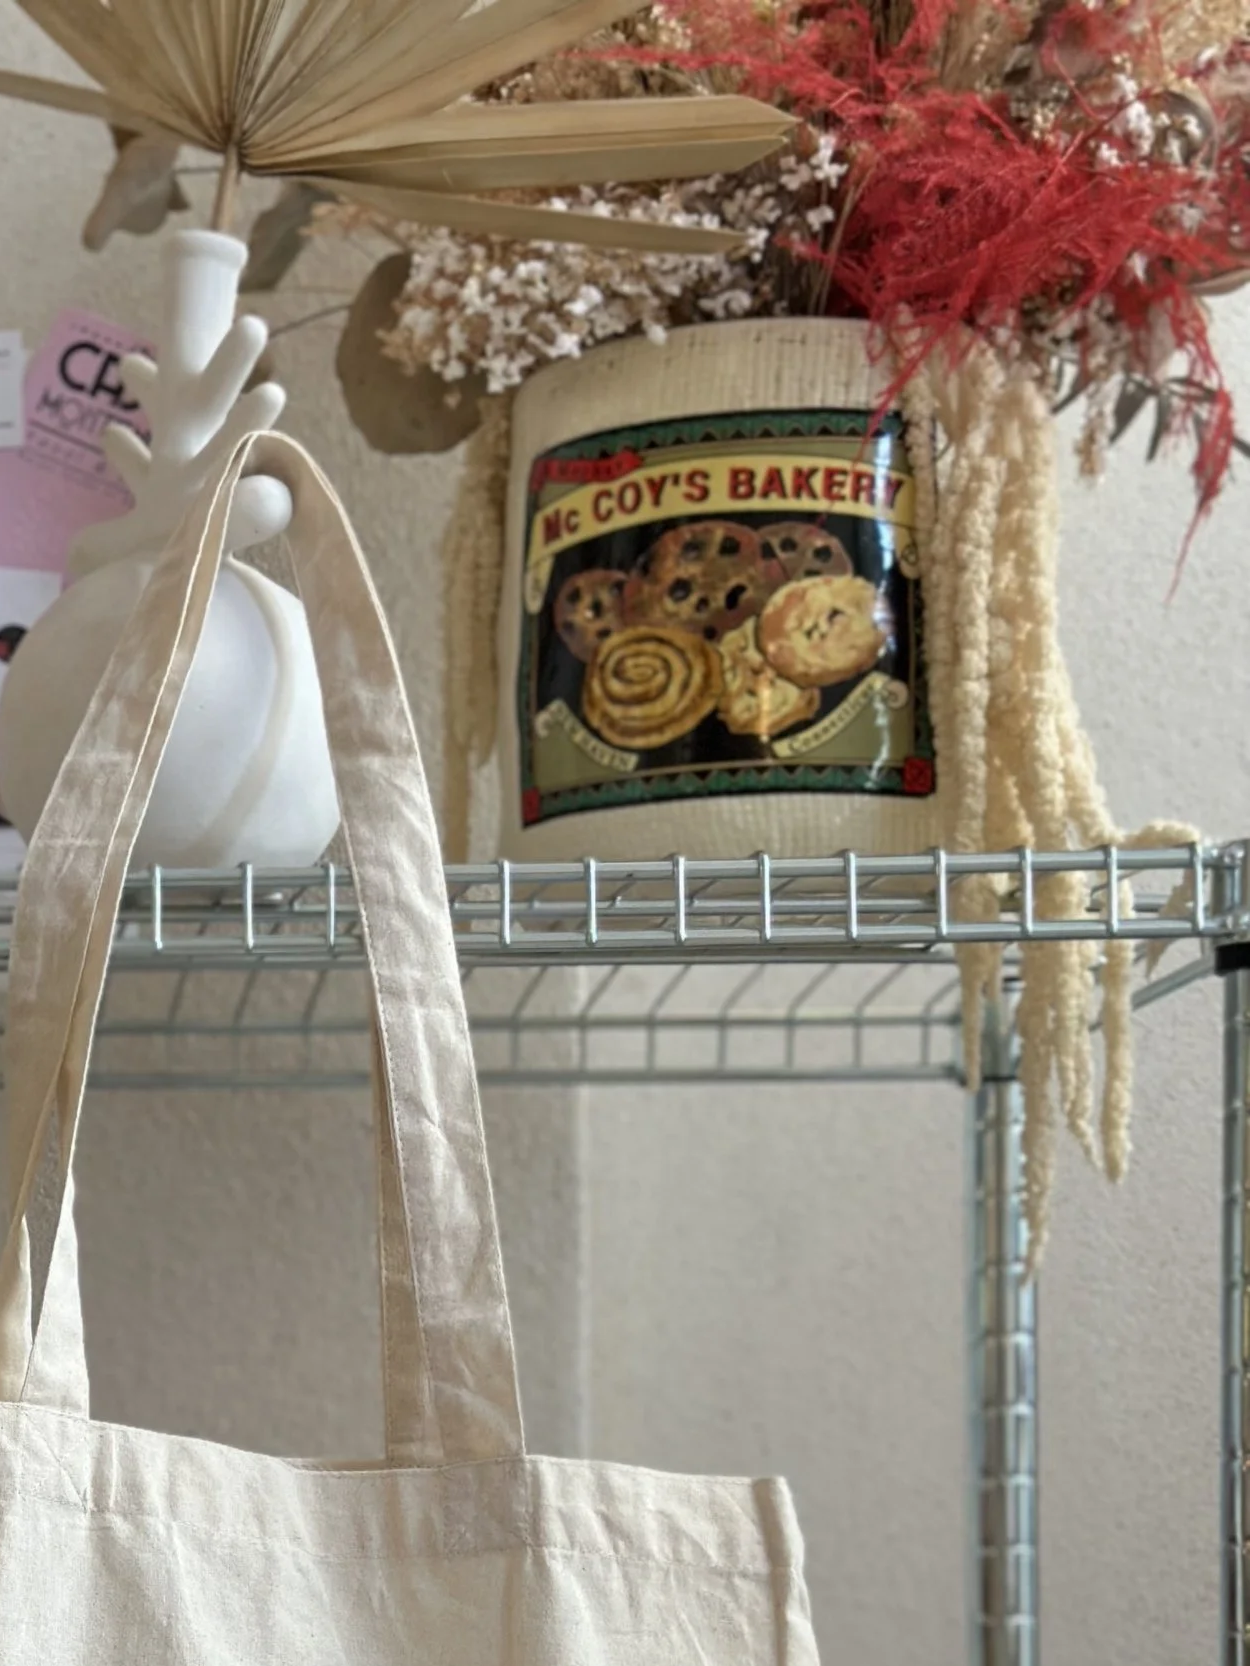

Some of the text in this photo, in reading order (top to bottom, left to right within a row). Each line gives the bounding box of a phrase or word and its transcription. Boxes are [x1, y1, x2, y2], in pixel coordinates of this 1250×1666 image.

[541, 509, 580, 546] Mc
[592, 468, 710, 524] COY'S
[728, 465, 905, 512] BAKERY
